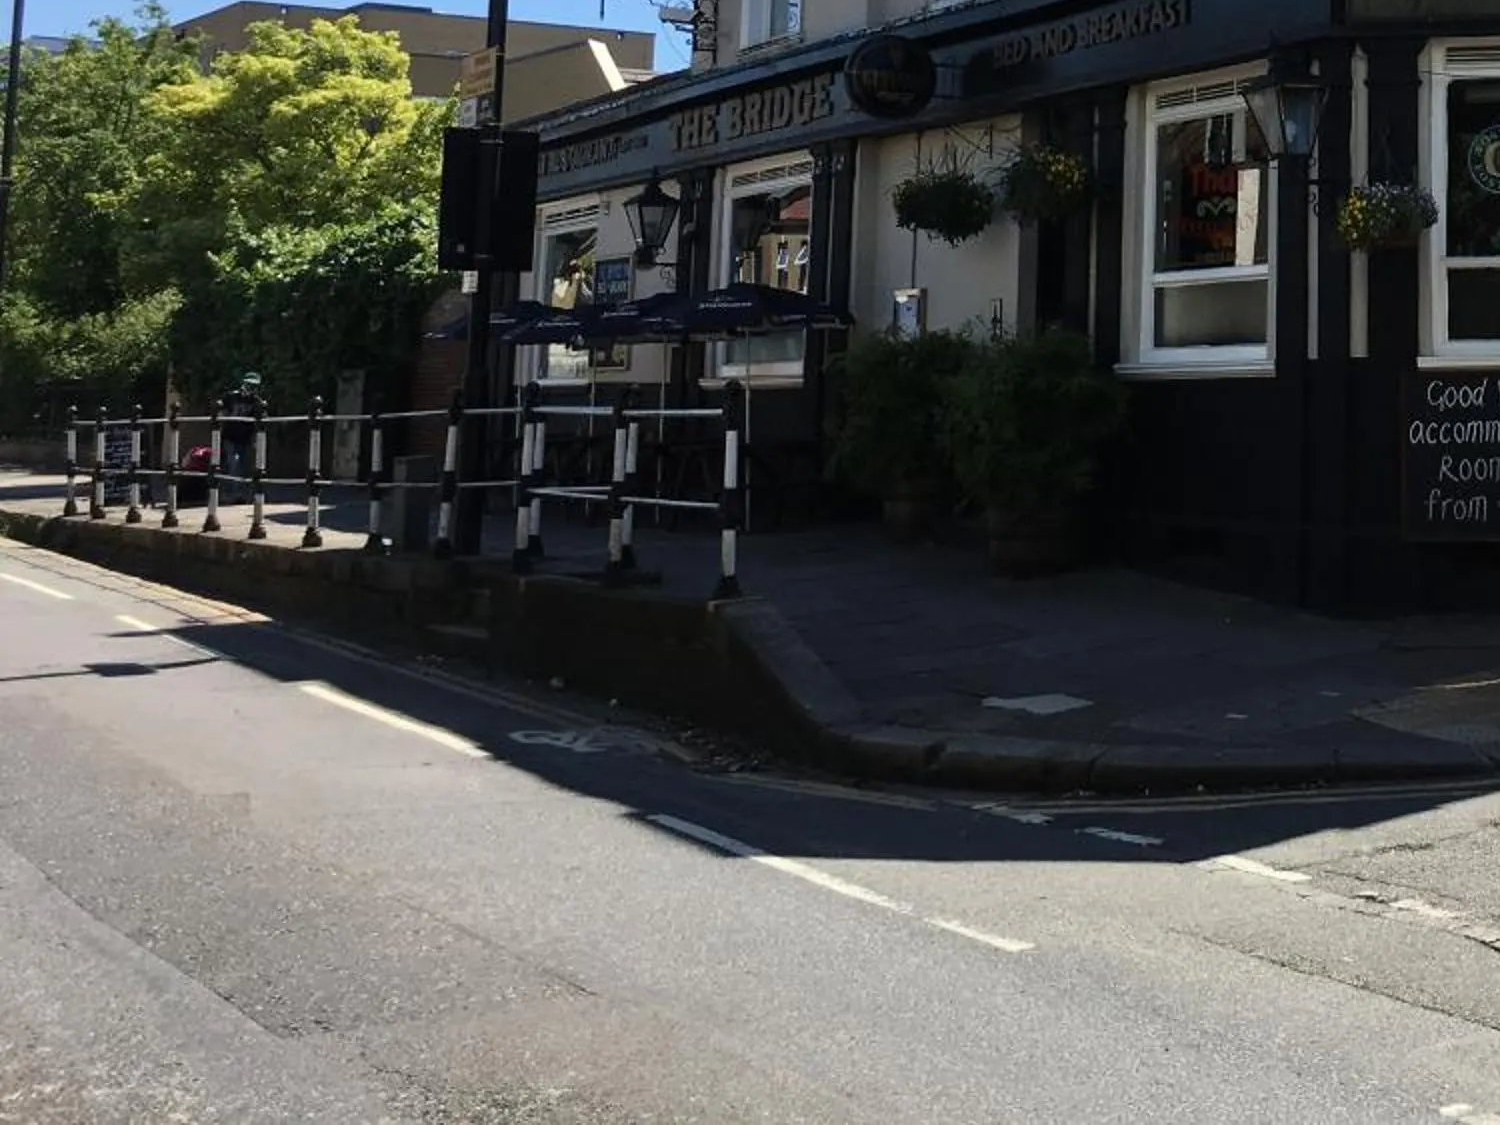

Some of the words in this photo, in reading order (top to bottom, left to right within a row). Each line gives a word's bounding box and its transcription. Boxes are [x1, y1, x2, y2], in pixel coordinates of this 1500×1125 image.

[1030, 24, 1075, 60] AND
[669, 105, 719, 152] THE
[725, 72, 836, 142] BRIDGE
[1426, 377, 1489, 412] Good
[1423, 487, 1488, 522] from
